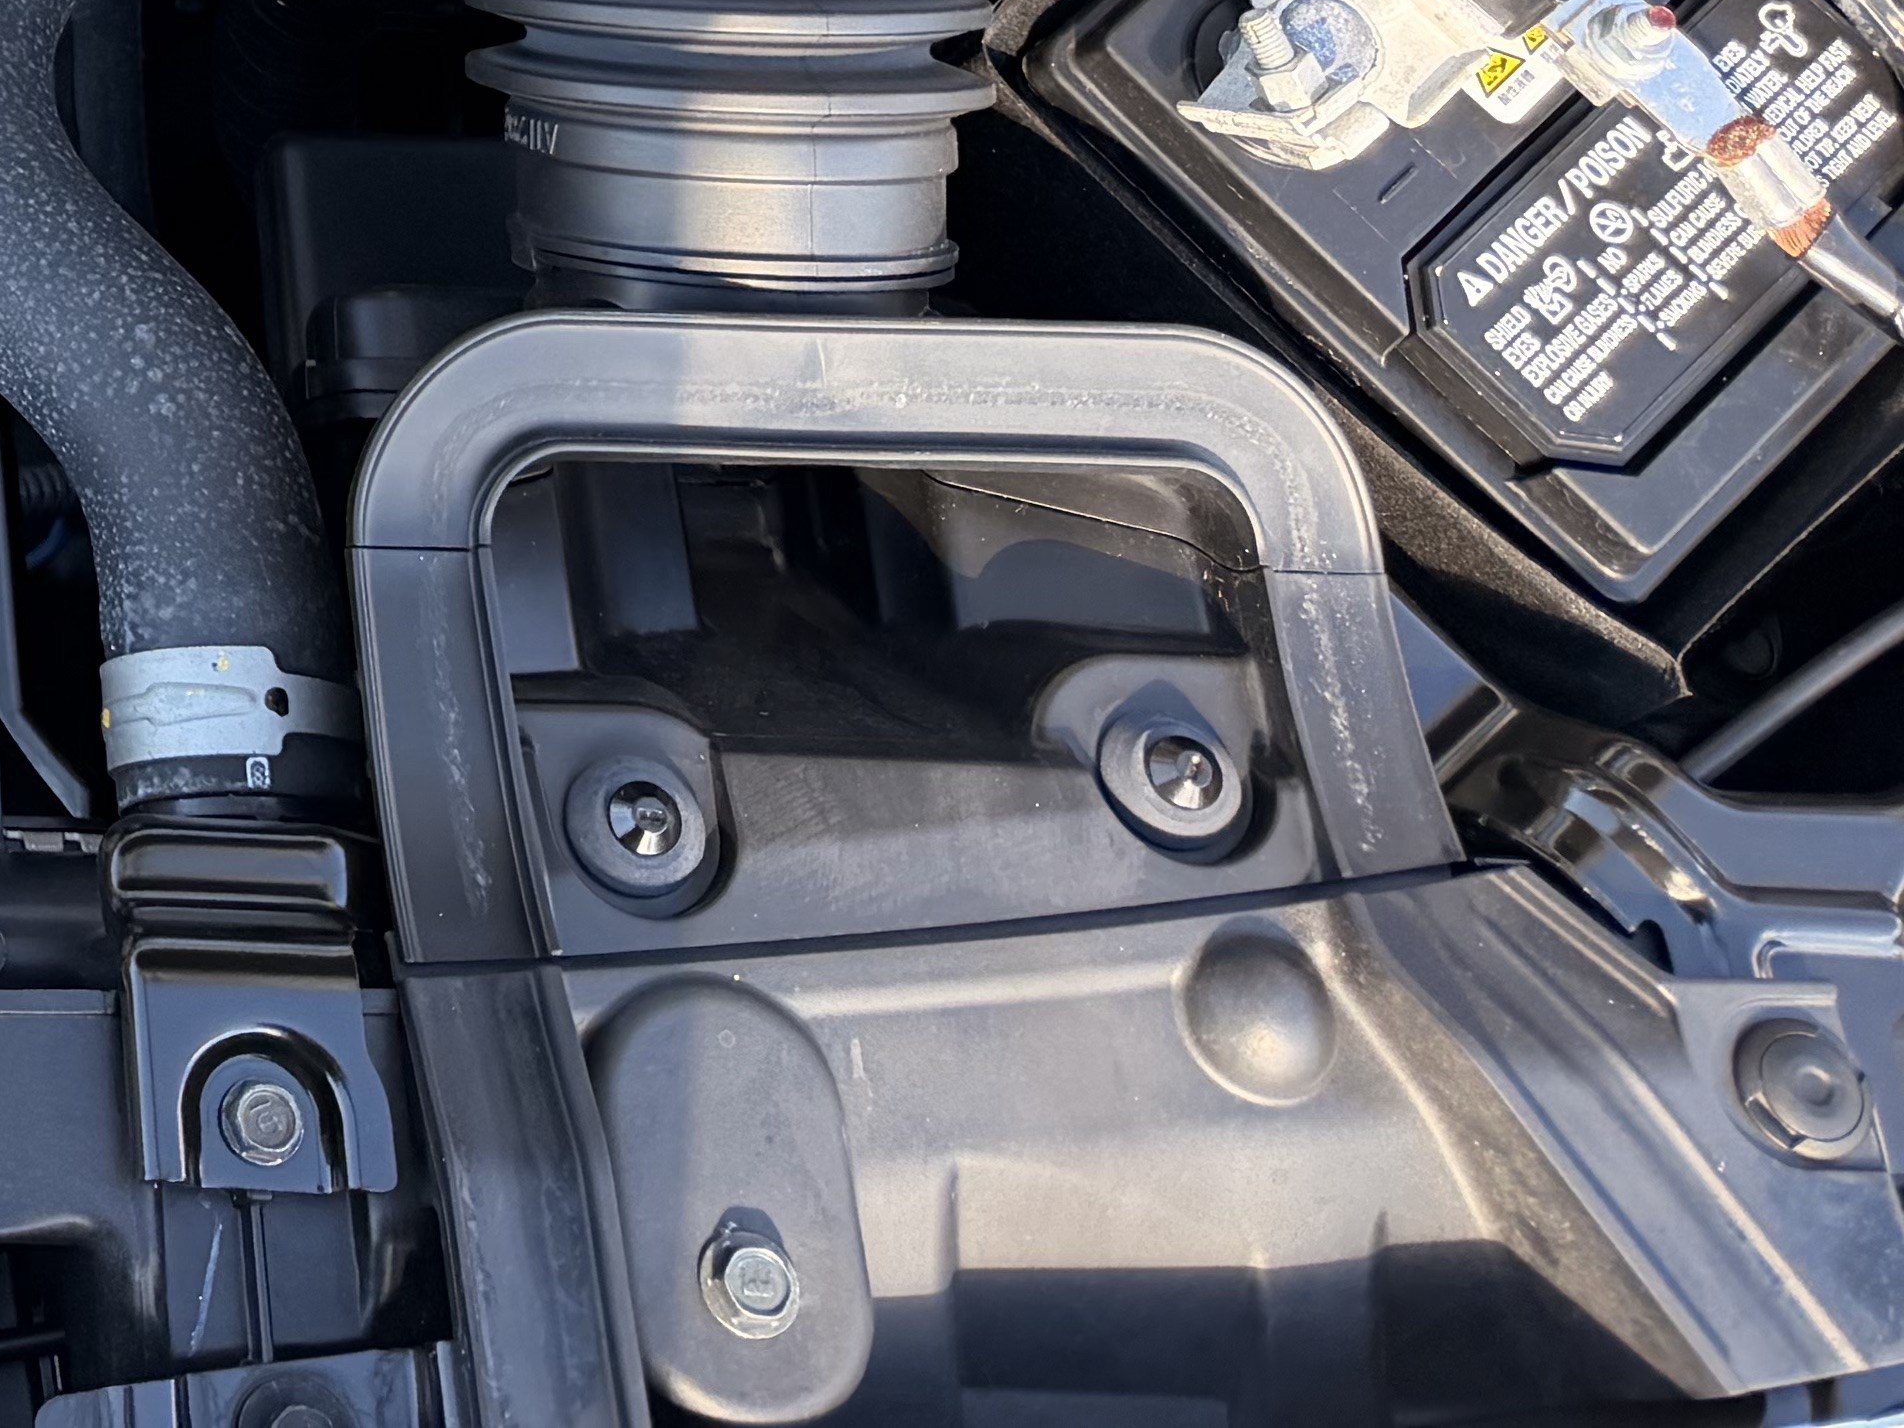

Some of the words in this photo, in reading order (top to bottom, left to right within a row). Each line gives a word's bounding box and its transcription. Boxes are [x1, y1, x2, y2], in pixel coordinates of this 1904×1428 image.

[1794, 60, 1830, 97] HELP
[1816, 37, 1854, 75] FAST
[1645, 167, 1709, 232] SULFURIC
[1686, 189, 1728, 232] CAUSE
[1595, 242, 1629, 276] NO
[1481, 302, 1533, 353] SHIELD
[1500, 328, 1544, 372] EYES
[1518, 321, 1588, 390] EXPLOSIVE
[1571, 288, 1620, 337] GASES
